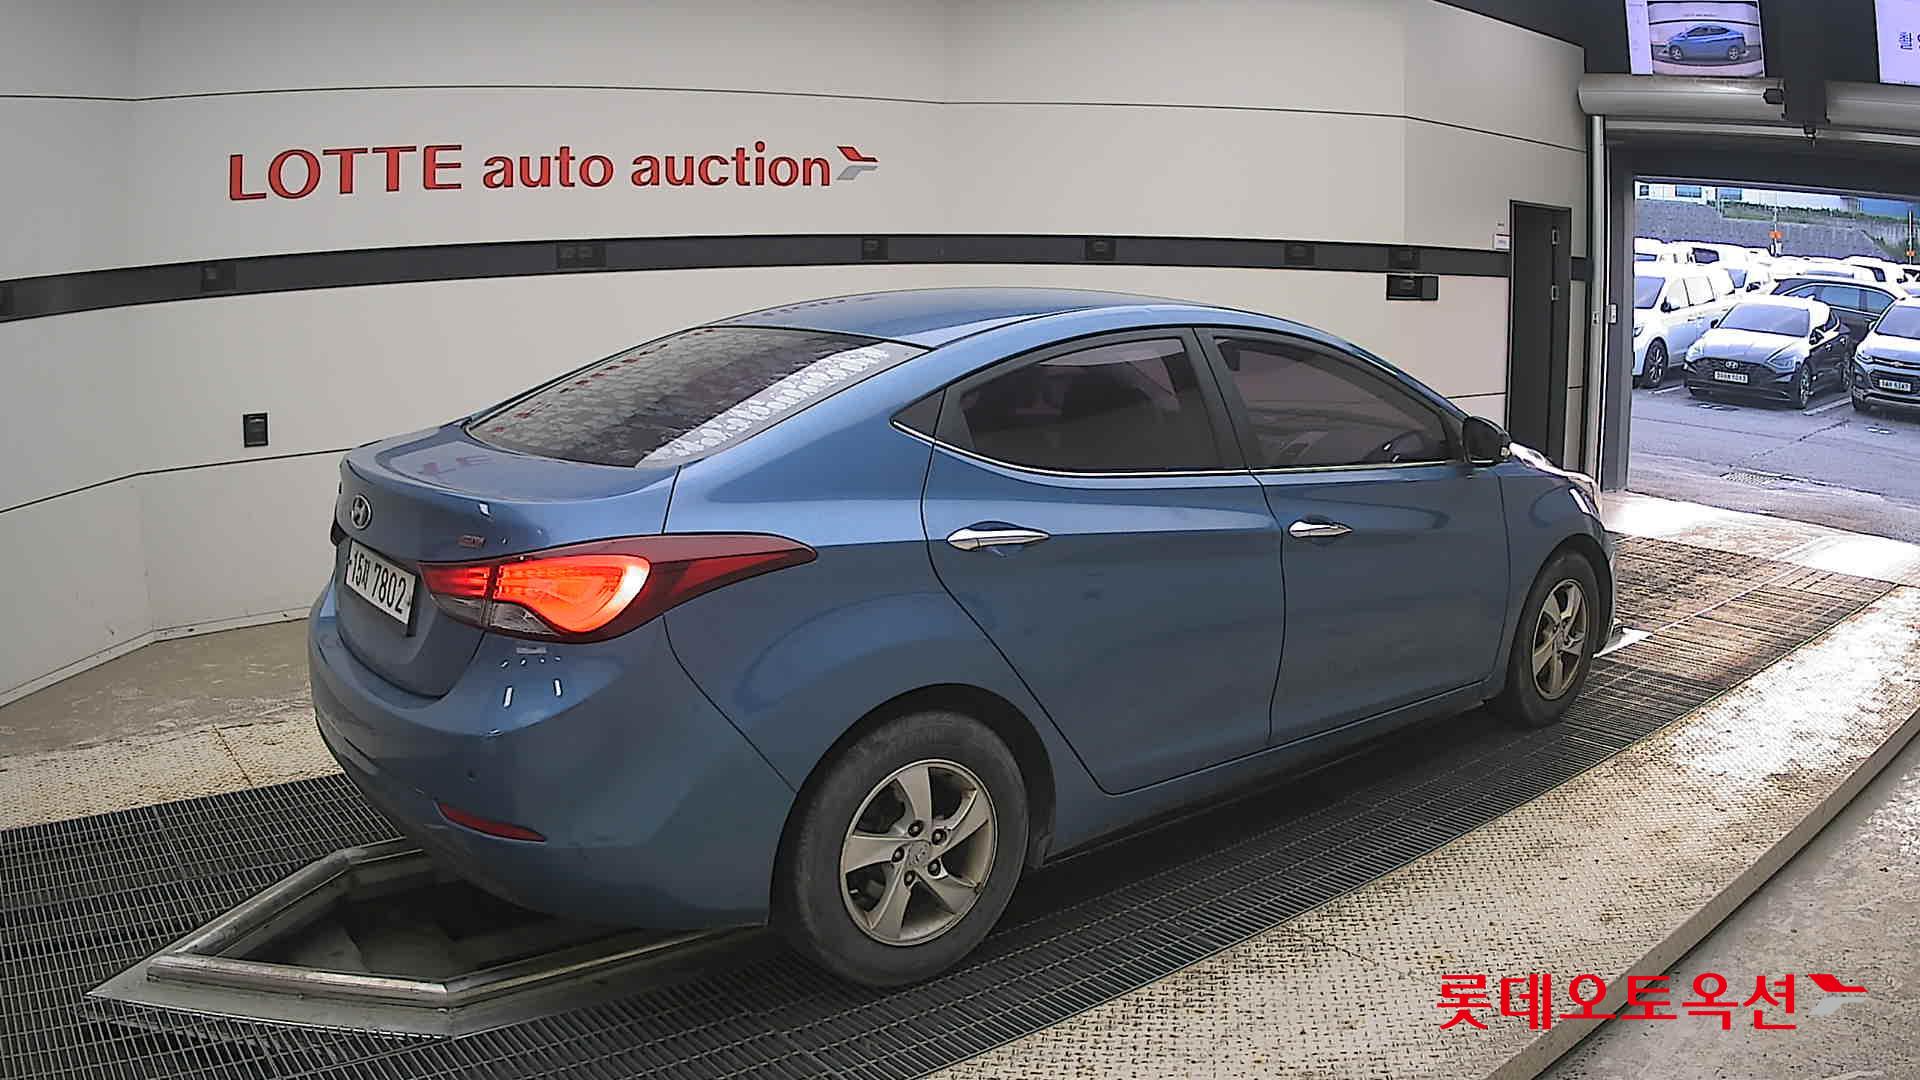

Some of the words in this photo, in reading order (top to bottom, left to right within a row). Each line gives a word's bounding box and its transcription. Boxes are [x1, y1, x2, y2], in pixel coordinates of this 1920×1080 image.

[228, 144, 463, 201] LOTTE
[482, 145, 615, 190] auto
[630, 140, 832, 188] auction
[372, 562, 407, 614] 7802
